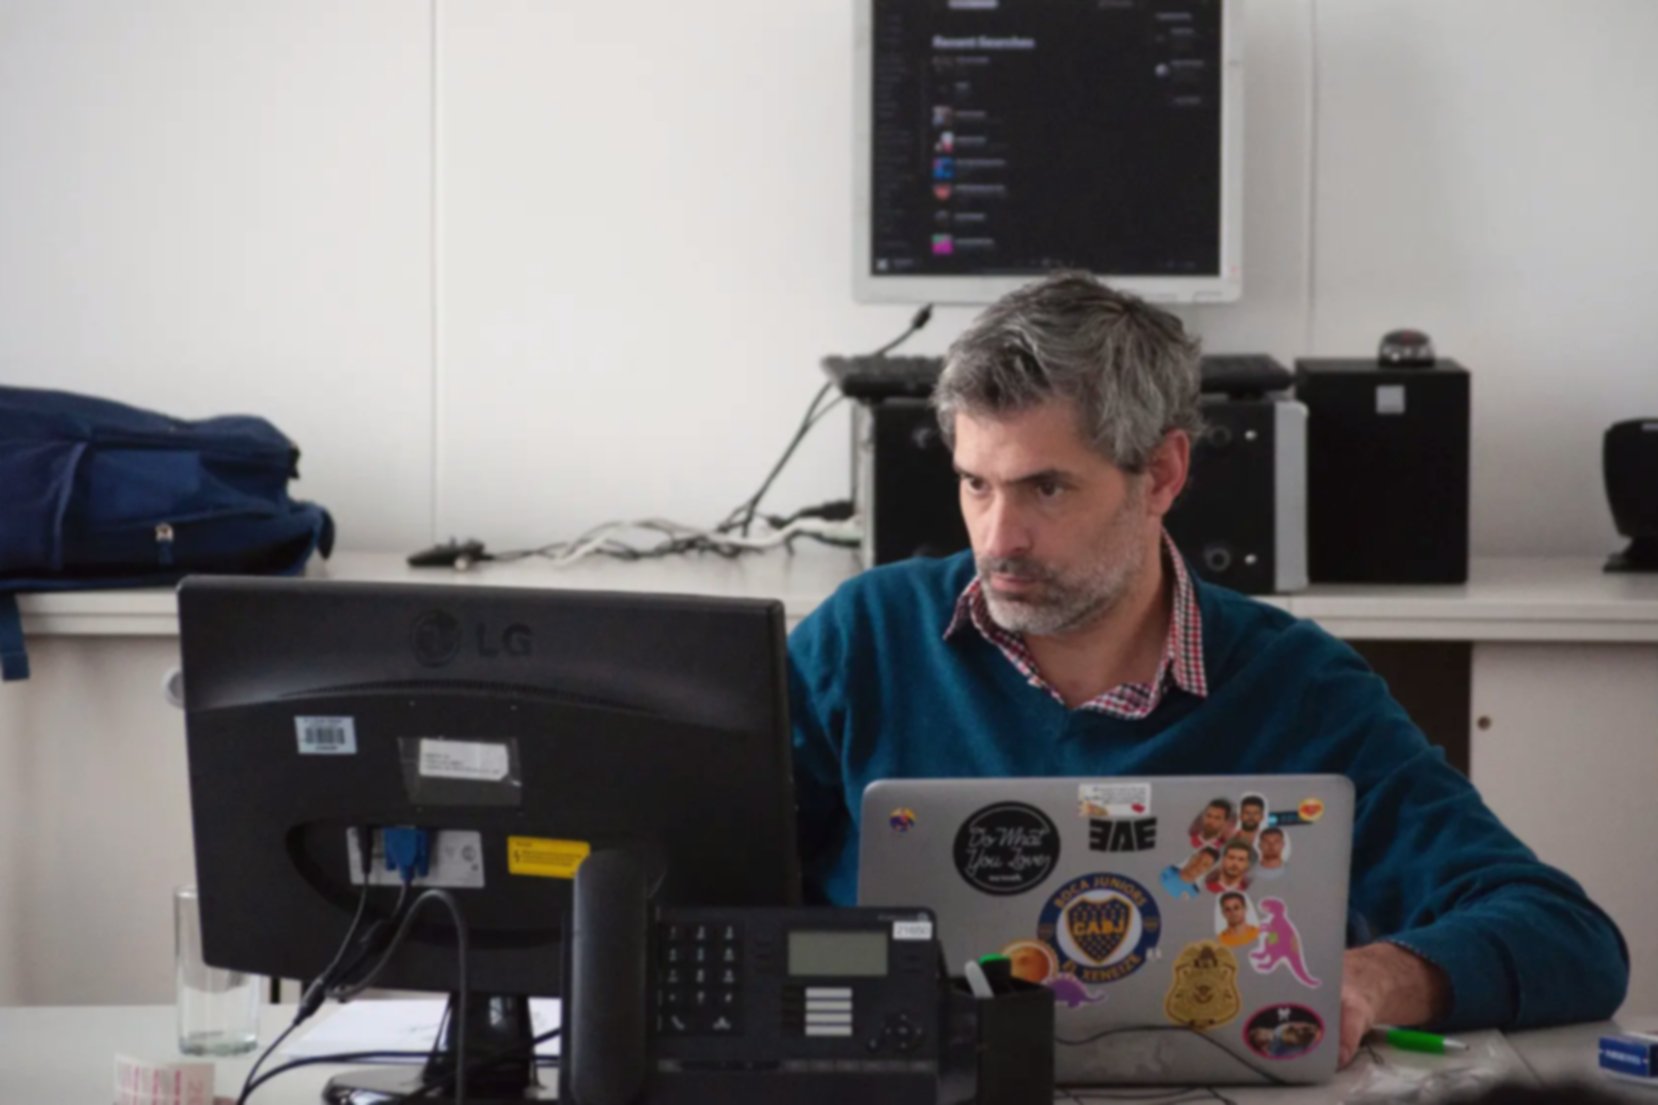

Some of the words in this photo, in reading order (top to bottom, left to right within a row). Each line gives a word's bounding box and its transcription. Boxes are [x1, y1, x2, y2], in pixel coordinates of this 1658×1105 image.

[477, 621, 534, 659] LG
[967, 825, 996, 849] Do
[996, 825, 1049, 848] What
[966, 847, 1003, 878] You
[1007, 846, 1051, 871] Love
[1054, 880, 1089, 909] BOCA
[1094, 876, 1147, 907] JUNIORS
[1073, 919, 1125, 936] CABJ
